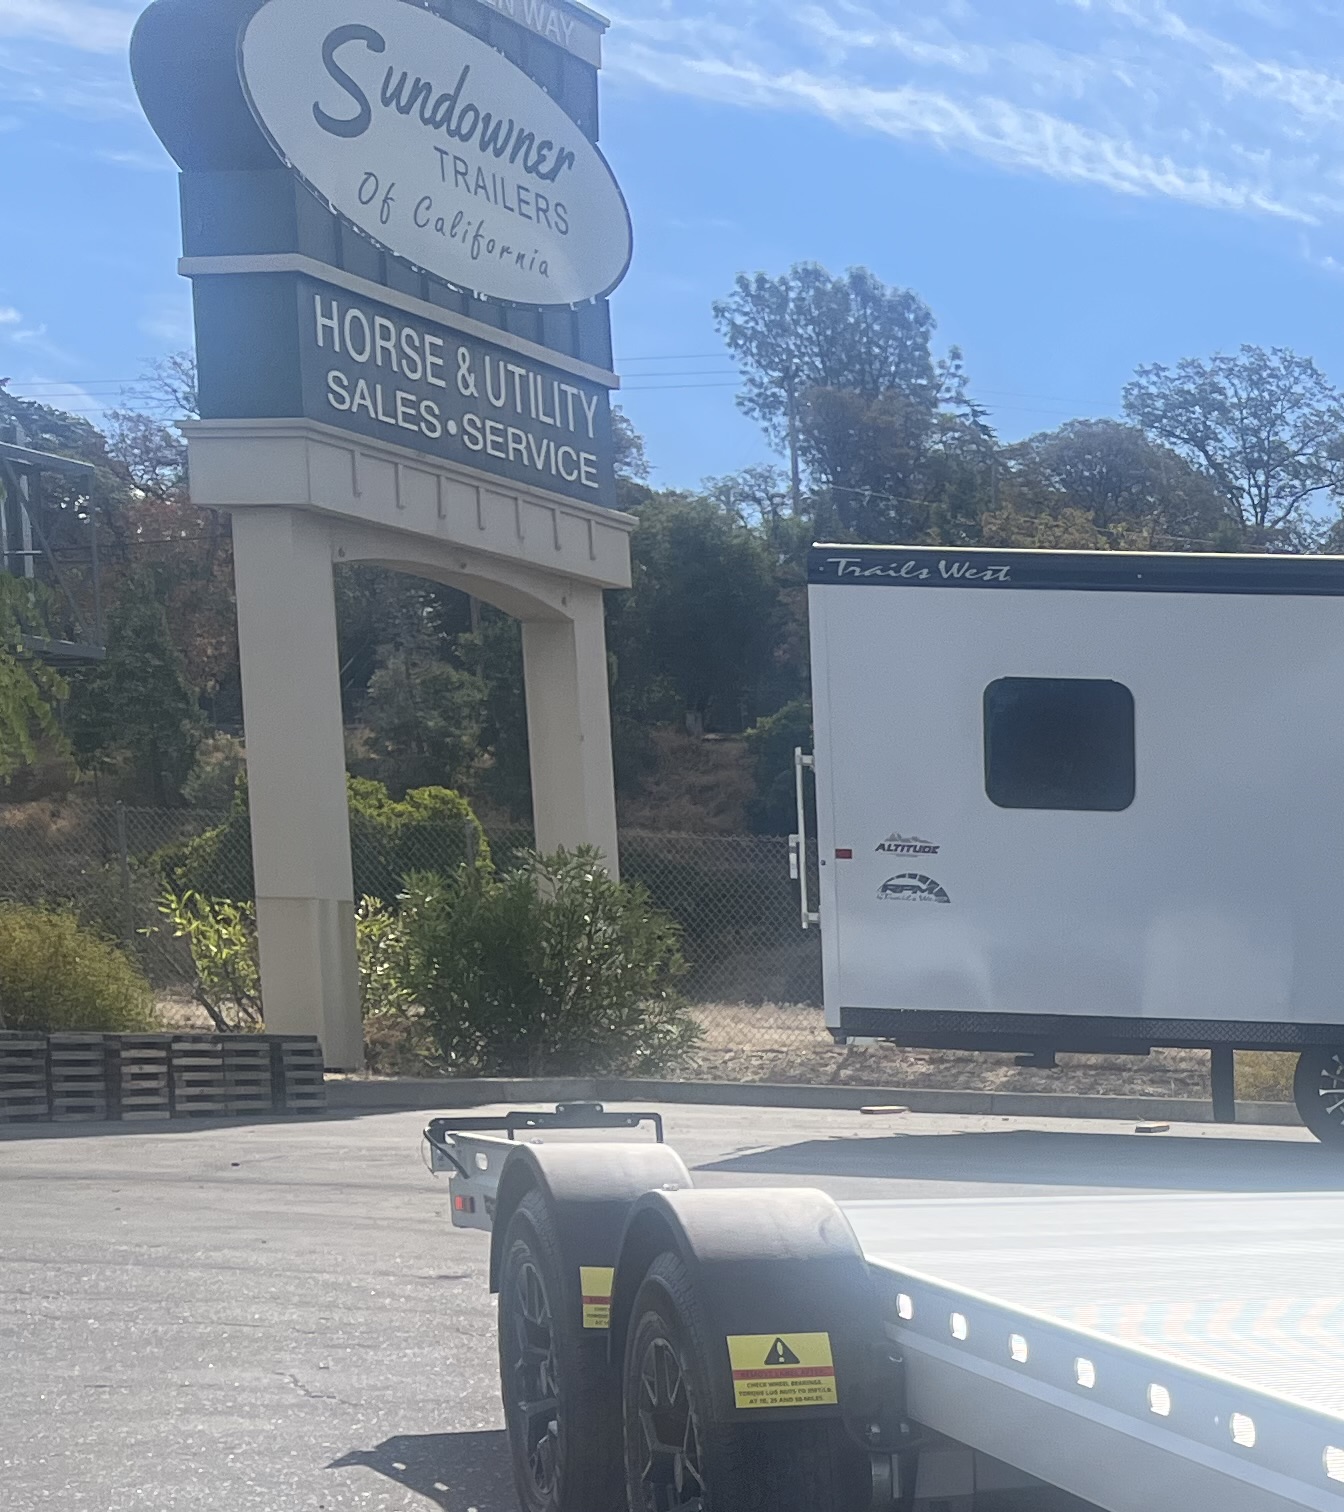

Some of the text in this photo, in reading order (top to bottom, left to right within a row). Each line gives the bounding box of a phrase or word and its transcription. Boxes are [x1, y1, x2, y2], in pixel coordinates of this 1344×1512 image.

[312, 23, 576, 184] Sundowner
[357, 171, 551, 278] Of California
[433, 146, 570, 236] TRAILERS
[313, 294, 599, 440] HORSE & UTILITY
[826, 557, 1011, 581] Trails West
[875, 843, 941, 854] ALTITUDE
